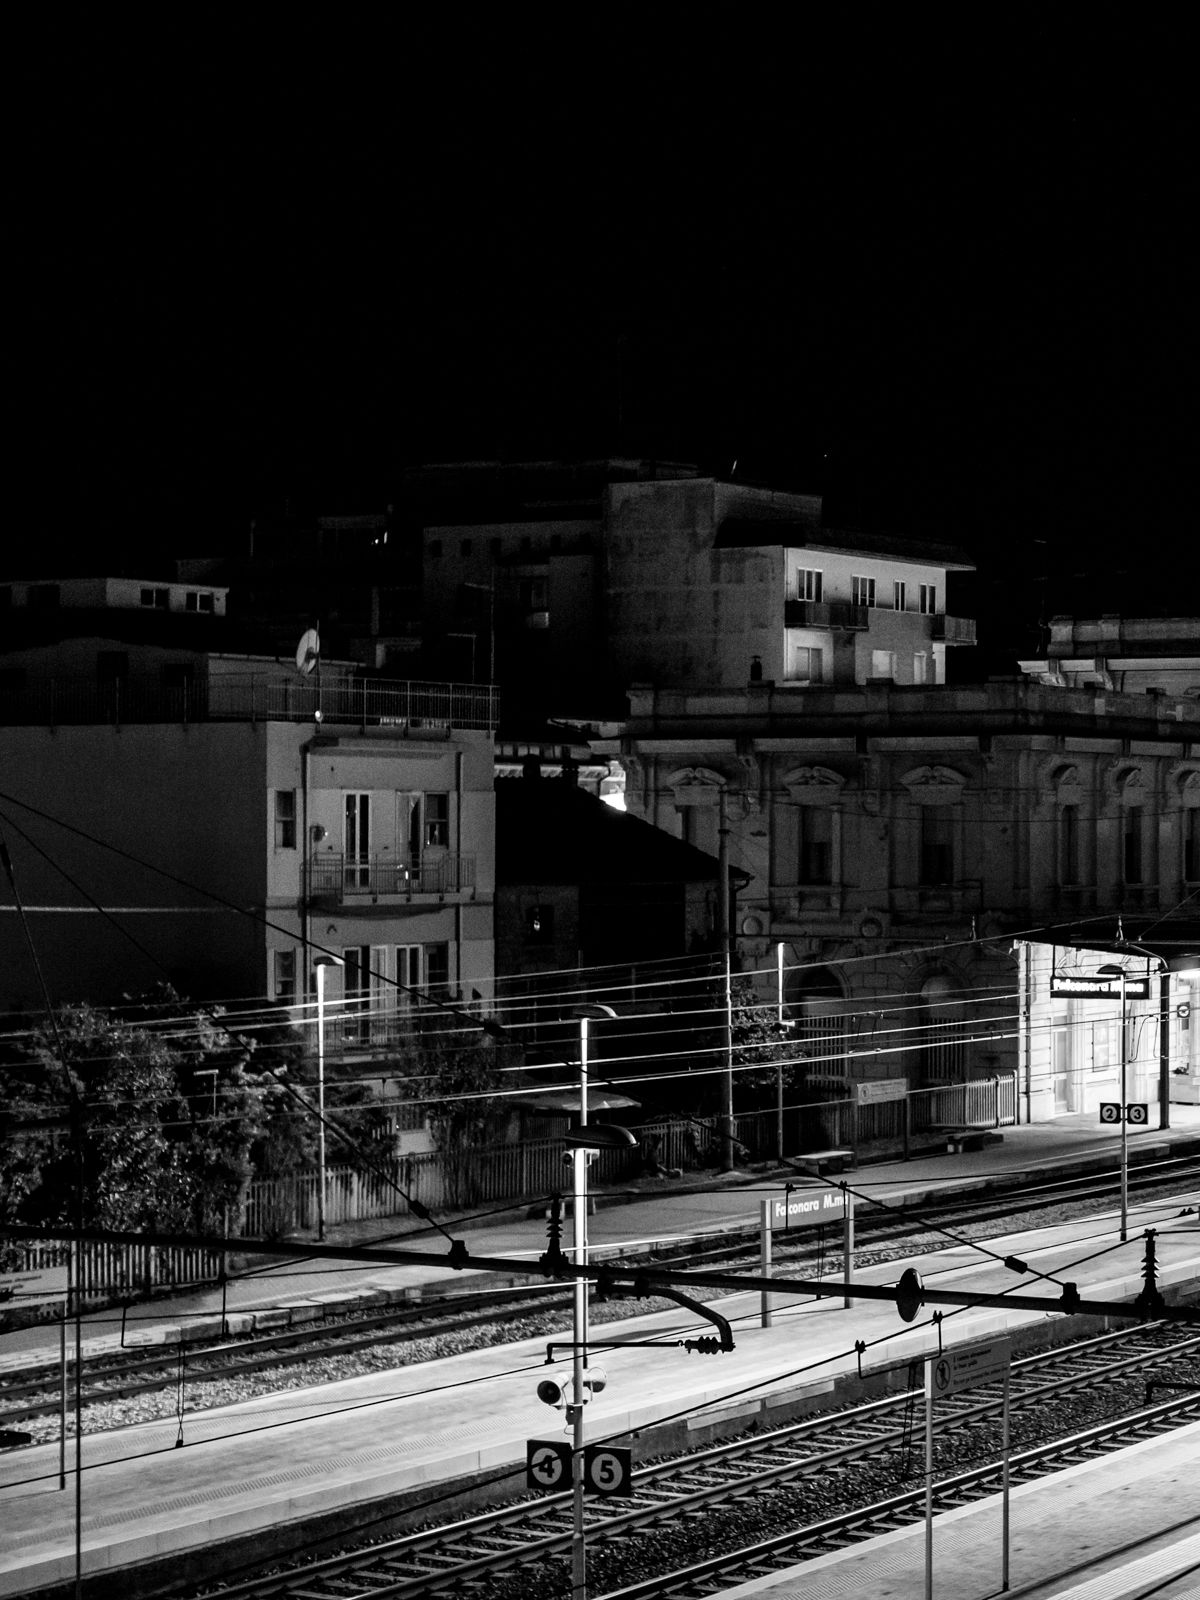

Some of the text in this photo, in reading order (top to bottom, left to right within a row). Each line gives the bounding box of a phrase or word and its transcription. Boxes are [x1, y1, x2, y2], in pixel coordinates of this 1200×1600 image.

[1105, 1108, 1142, 1120] 2 3
[775, 1199, 820, 1217] Faconara
[538, 1454, 615, 1484] 4 5
